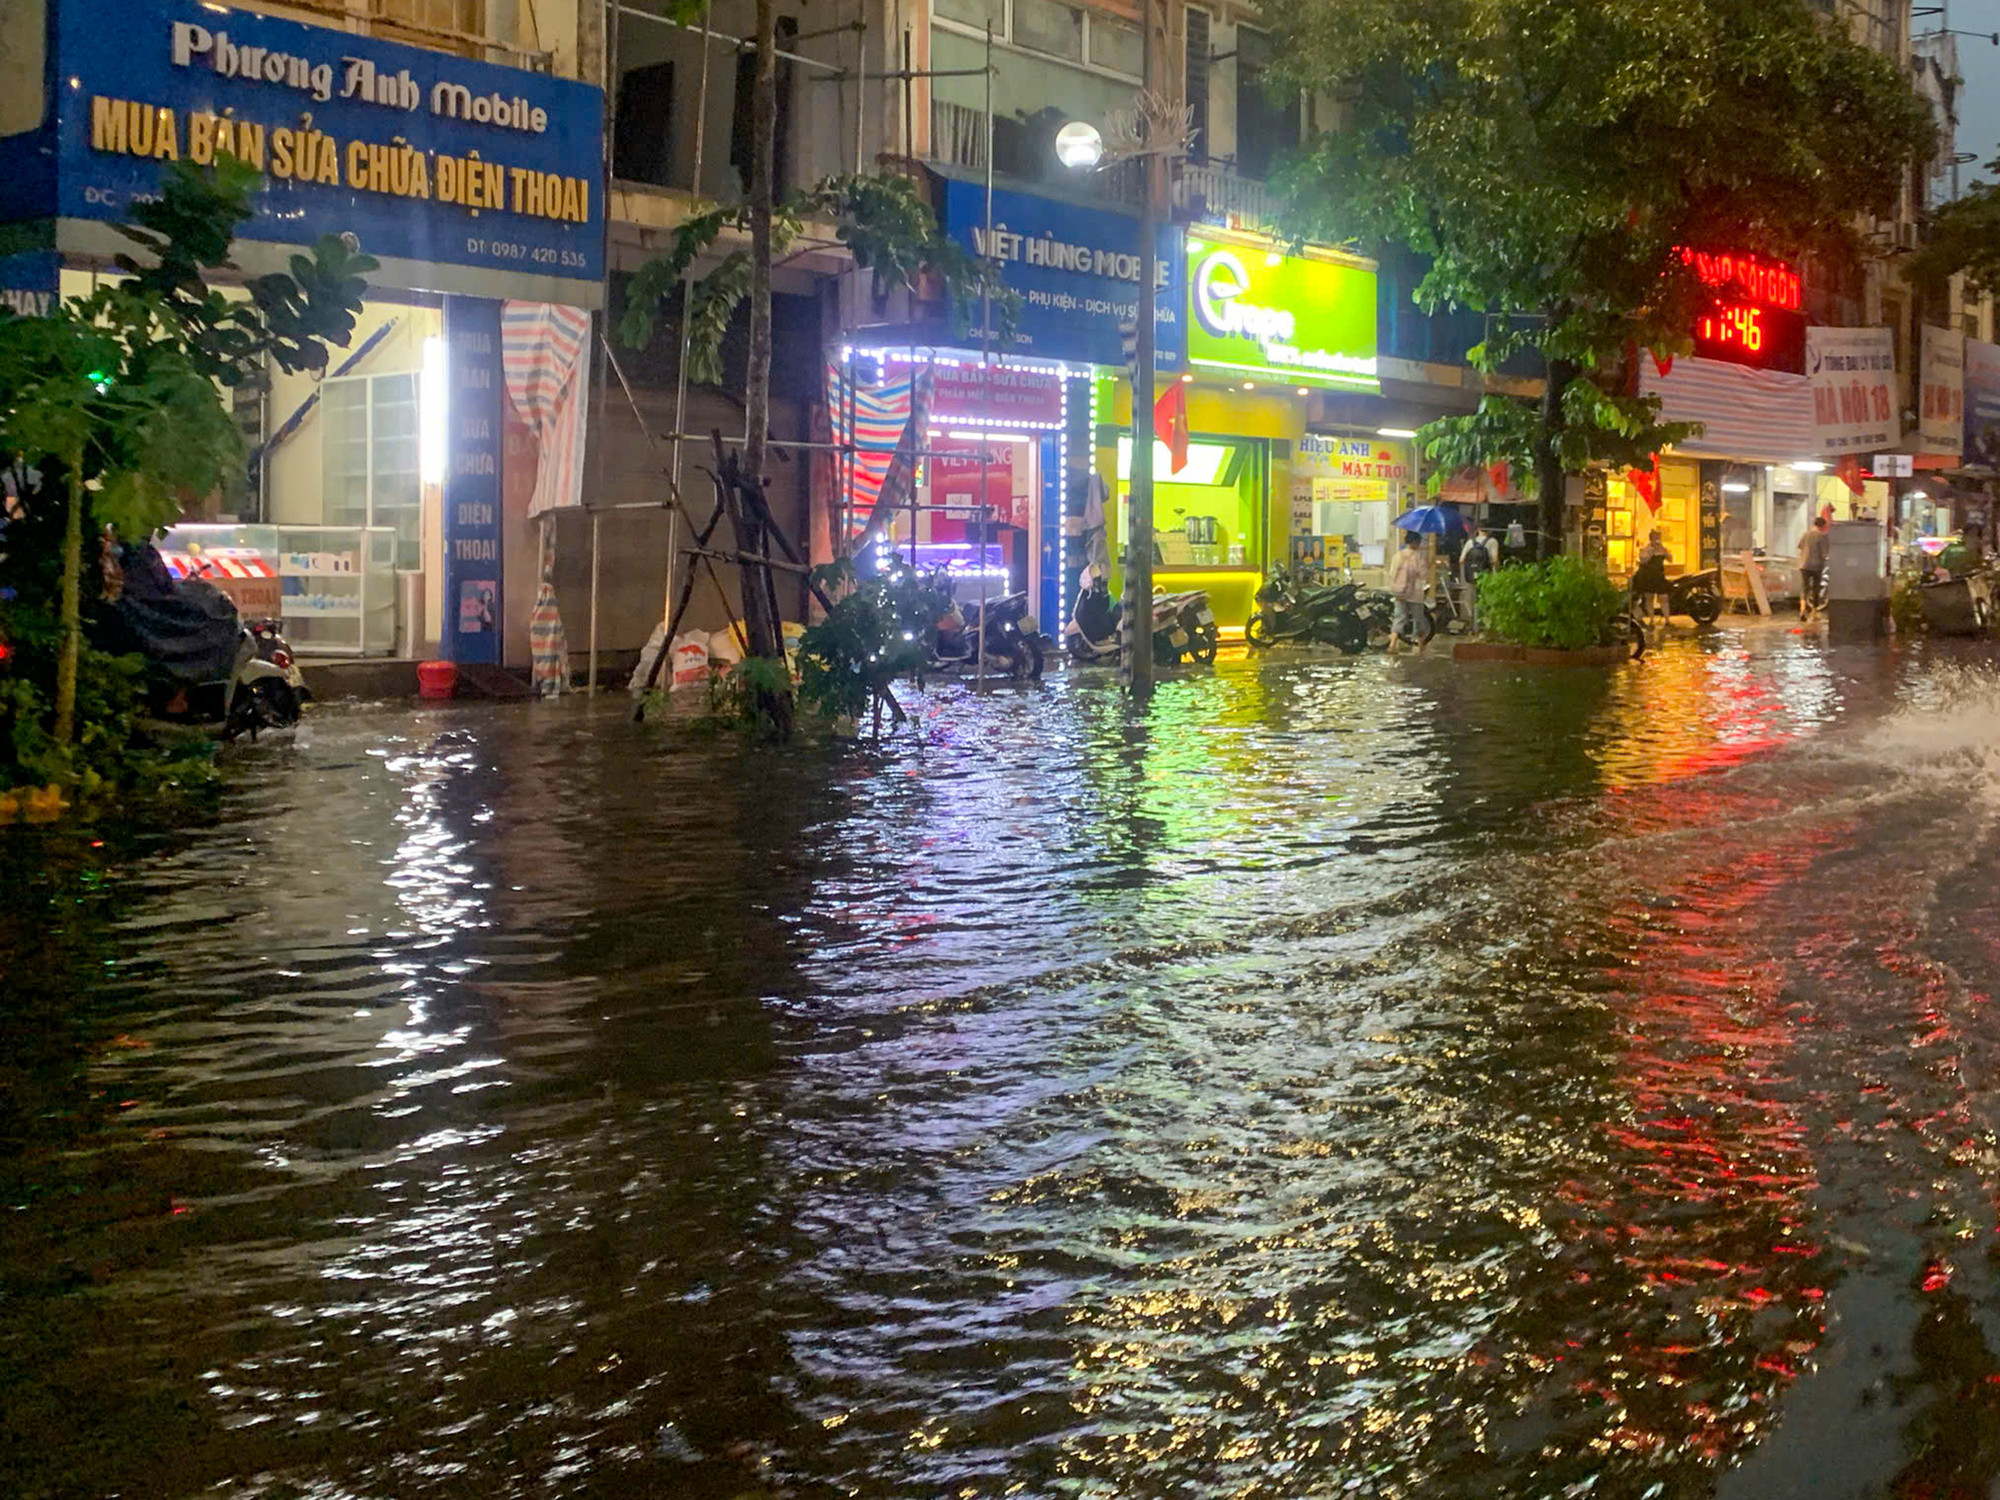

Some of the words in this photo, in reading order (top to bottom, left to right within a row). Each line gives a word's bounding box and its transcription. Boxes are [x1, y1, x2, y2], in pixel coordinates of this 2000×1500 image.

[171, 21, 333, 102] Phương
[339, 56, 420, 112] Anh
[431, 81, 548, 133] Mobile
[92, 95, 179, 161] MUA
[189, 107, 264, 170] BÁN
[272, 111, 339, 185] SỬA
[347, 136, 429, 199] CHỮA
[436, 150, 504, 218] ĐIỆN
[511, 166, 589, 231] THOẠI
[492, 241, 527, 259] 0987
[531, 248, 557, 263] 420
[971, 222, 1023, 268] VIỆT
[1025, 230, 1092, 273] HÙNG
[1093, 249, 1170, 287] MOBLE
[1029, 289, 1051, 311] PHỤ
[1052, 292, 1077, 313] KIỆN
[1085, 299, 1111, 317] DỊCH
[1112, 305, 1127, 320] VỤ
[1871, 384, 1891, 422] 18
